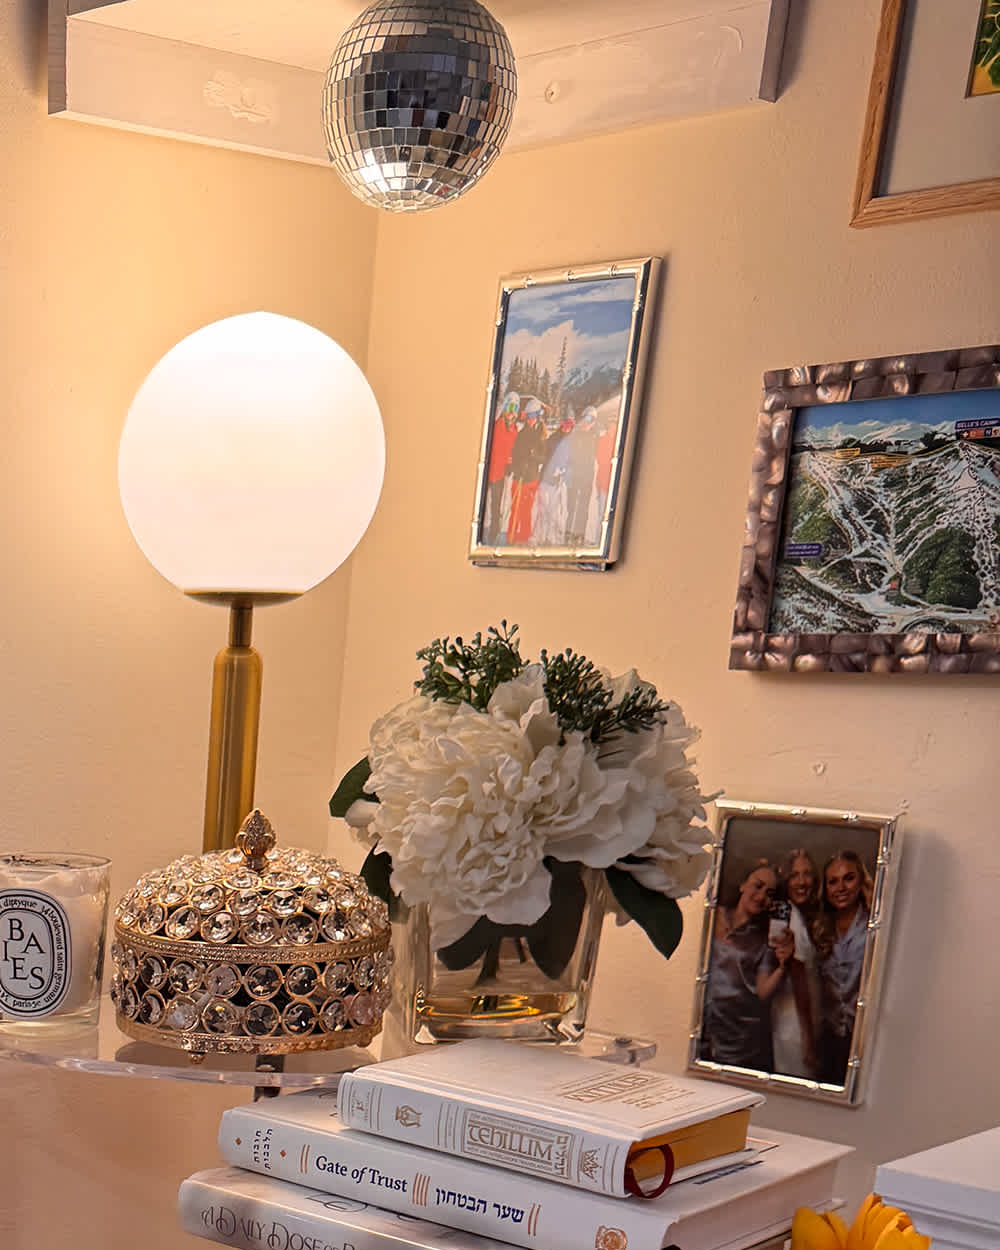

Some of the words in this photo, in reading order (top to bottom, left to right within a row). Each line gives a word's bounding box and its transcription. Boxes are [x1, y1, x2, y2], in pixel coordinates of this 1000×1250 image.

[3, 898, 38, 909] diptyque
[49, 910, 64, 950] boulevard
[56, 951, 65, 971] saint
[45, 973, 62, 1003] germain
[467, 1123, 553, 1161] TEHILLIM
[316, 1155, 347, 1177] Gate
[351, 1166, 369, 1184] of
[369, 1169, 408, 1193] Trust
[435, 1187, 487, 1214] הבטחון
[493, 1202, 525, 1223] שער
[201, 1206, 214, 1225] A
[215, 1207, 266, 1240] DAILY
